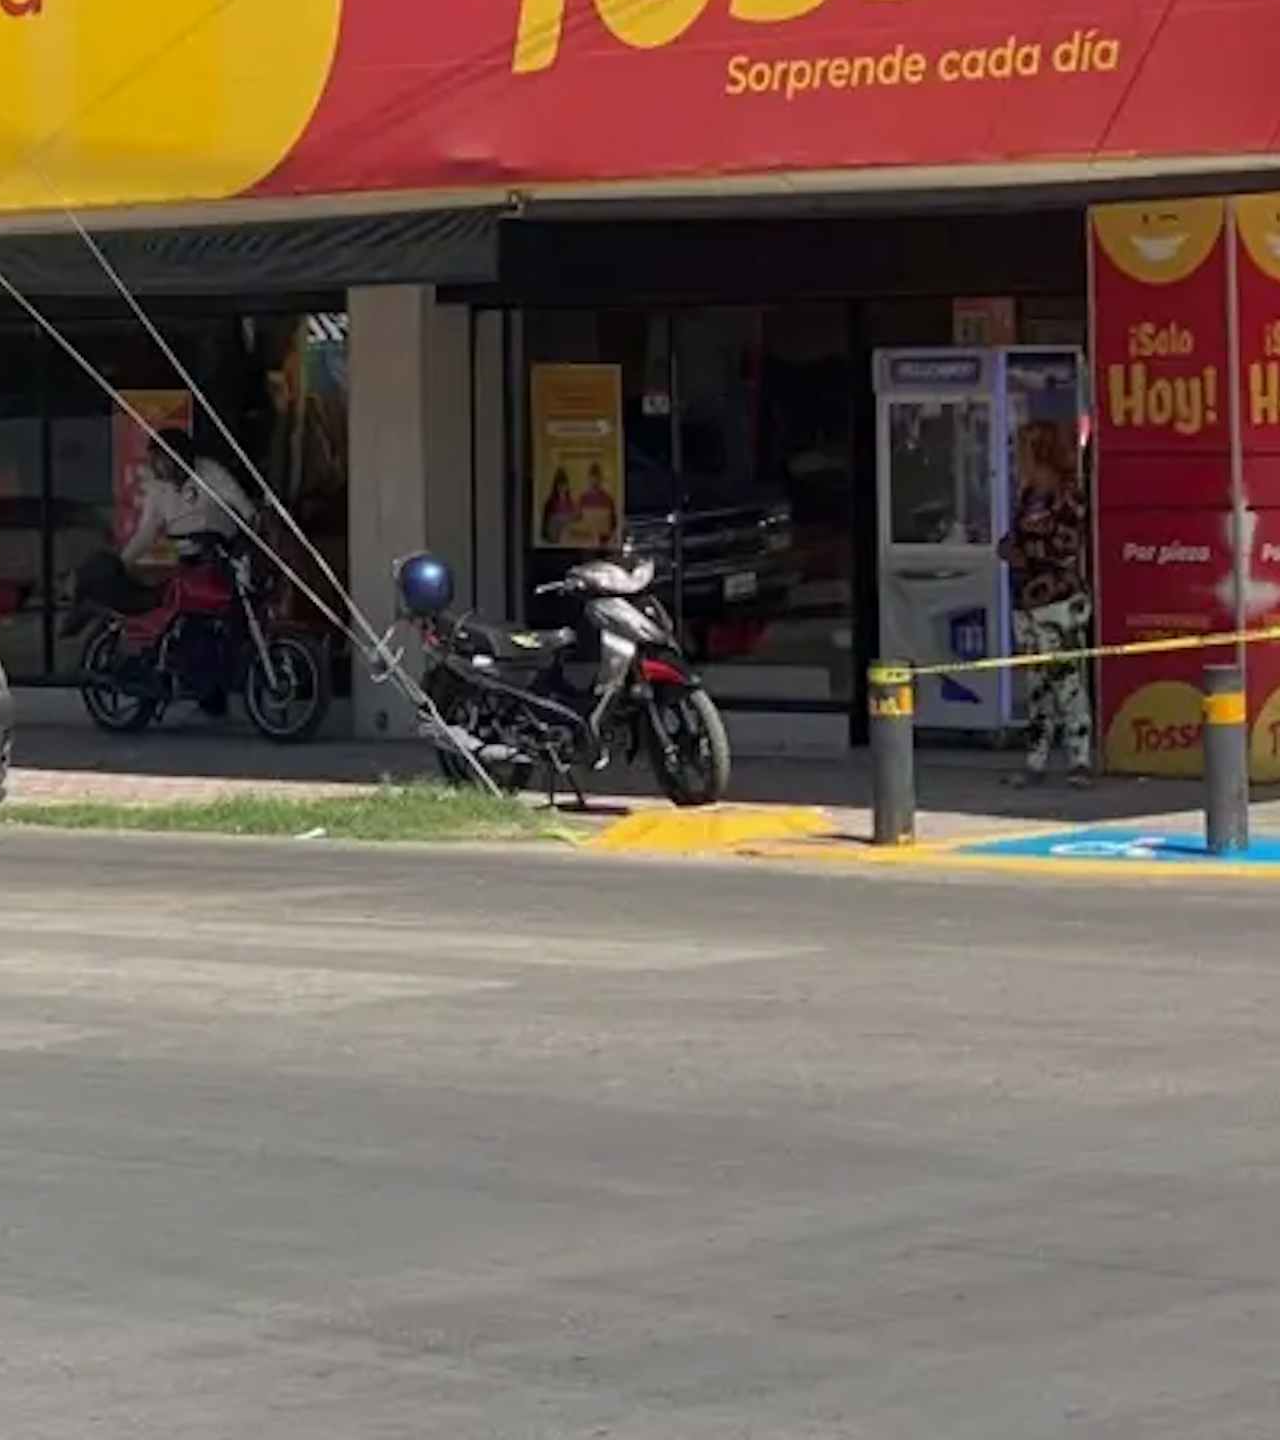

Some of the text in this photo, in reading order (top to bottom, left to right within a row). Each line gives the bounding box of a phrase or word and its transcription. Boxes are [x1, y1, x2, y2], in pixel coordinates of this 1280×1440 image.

[725, 28, 1120, 101] Sorprende cada día
[1129, 320, 1195, 357] ¡Solo
[1108, 362, 1219, 435] Hoy!
[1131, 717, 1203, 753] Toss
